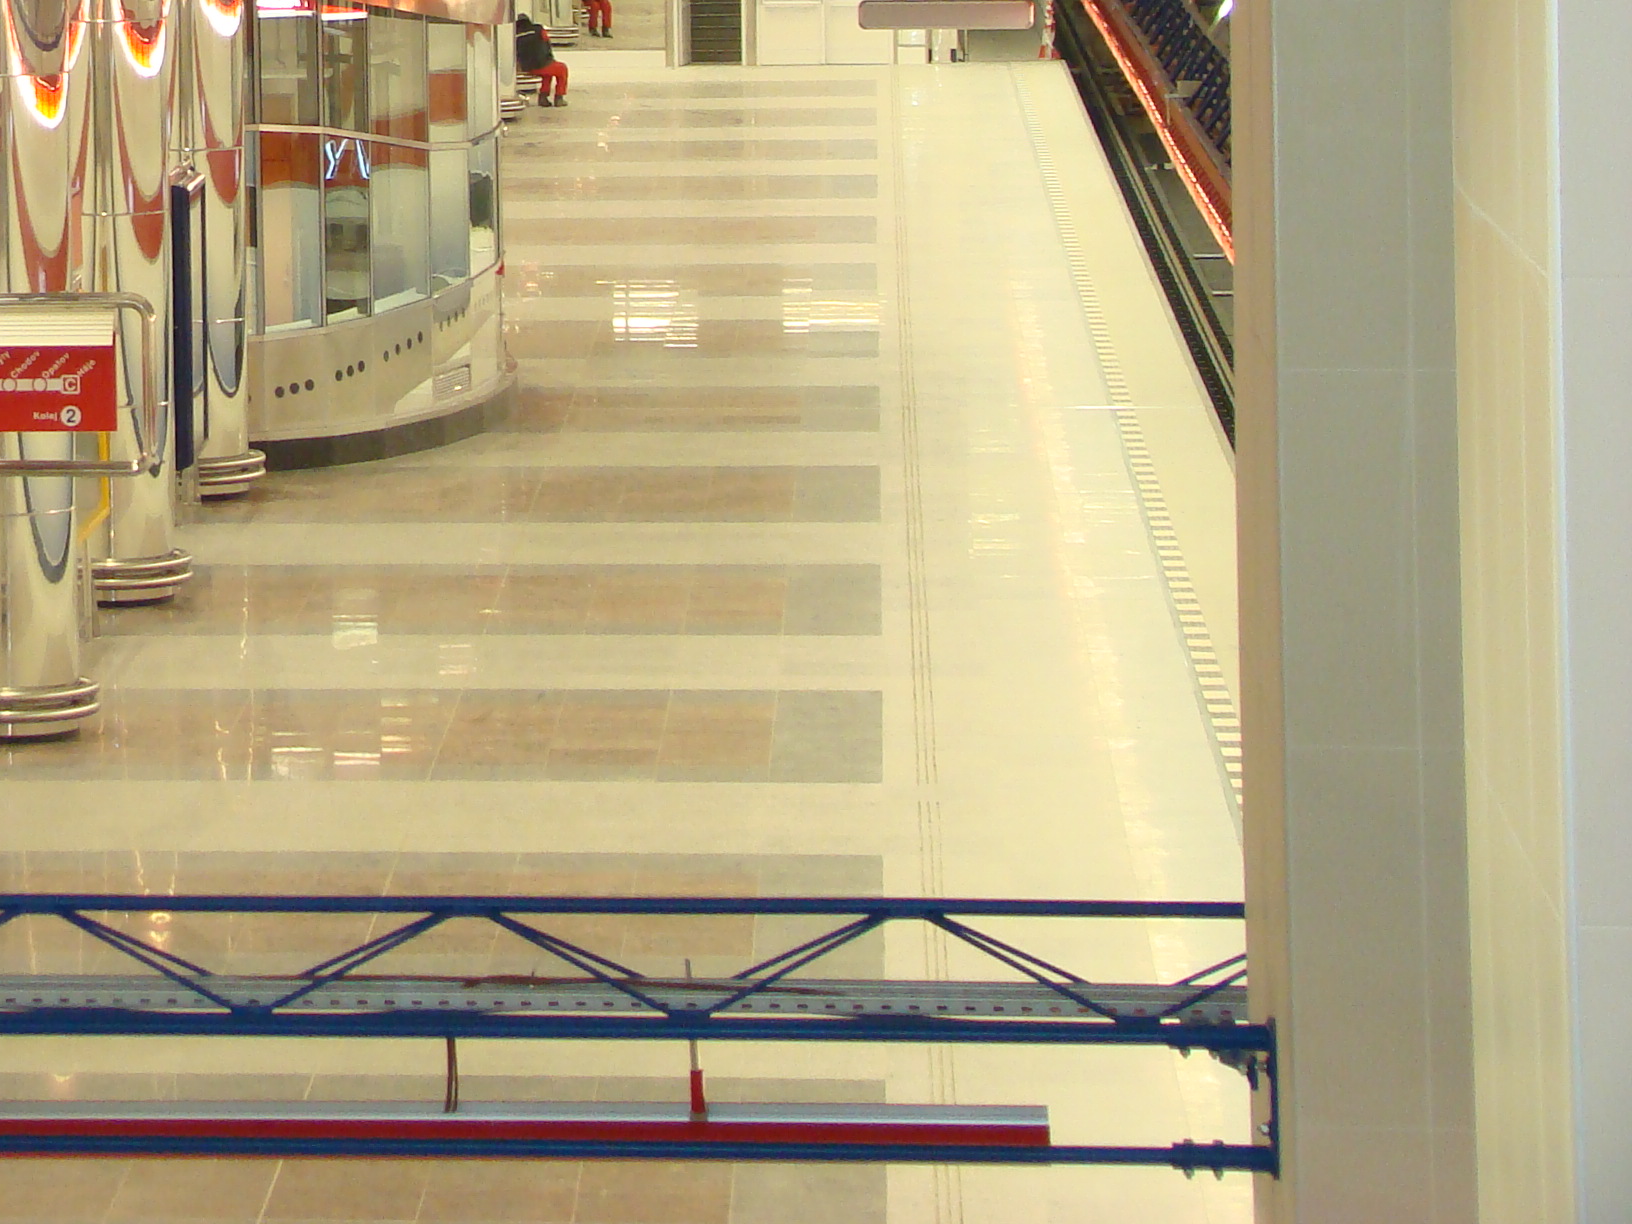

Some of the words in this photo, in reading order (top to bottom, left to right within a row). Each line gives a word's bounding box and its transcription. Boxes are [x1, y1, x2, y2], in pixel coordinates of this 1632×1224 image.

[10, 351, 40, 378] Chodov
[42, 353, 70, 378] Opatov
[65, 379, 76, 391] C
[33, 412, 58, 421] Kolej
[66, 409, 76, 423] 2
